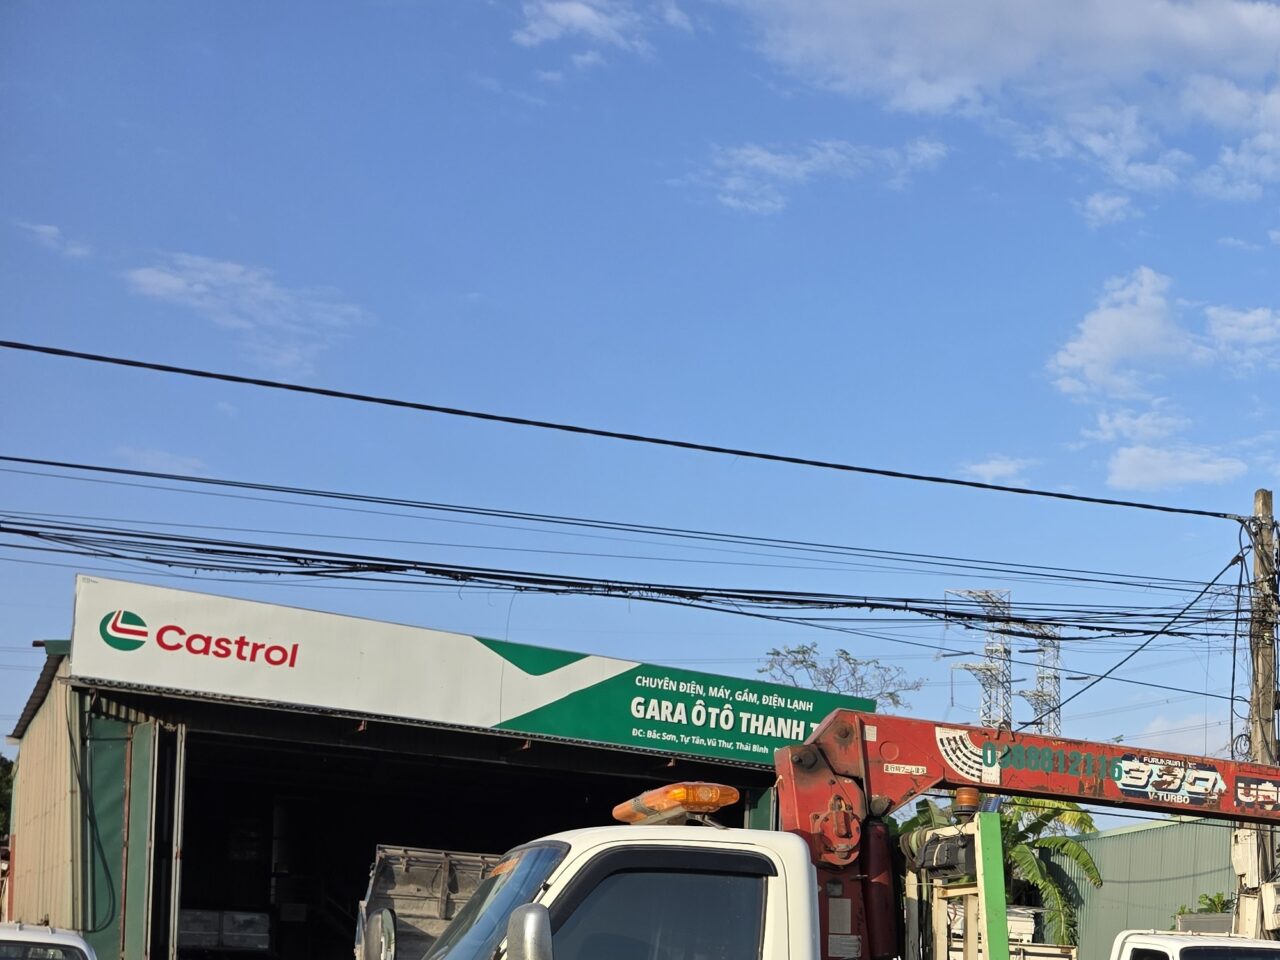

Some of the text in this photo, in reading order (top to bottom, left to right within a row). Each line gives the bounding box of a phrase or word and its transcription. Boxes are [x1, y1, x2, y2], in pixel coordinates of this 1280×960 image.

[156, 625, 299, 668] Castrol
[635, 675, 677, 692] CHUYÊN
[679, 681, 706, 697] ĐIỆN,
[708, 685, 733, 701] MÁY,
[762, 694, 785, 709] ĐIỆN
[787, 699, 814, 713] LẠNH
[631, 697, 687, 725] GARA
[691, 700, 735, 731] ÔTÔ
[740, 712, 806, 741] THANH
[632, 728, 646, 738] ĐC:
[1148, 791, 1190, 804] V-TURBO
